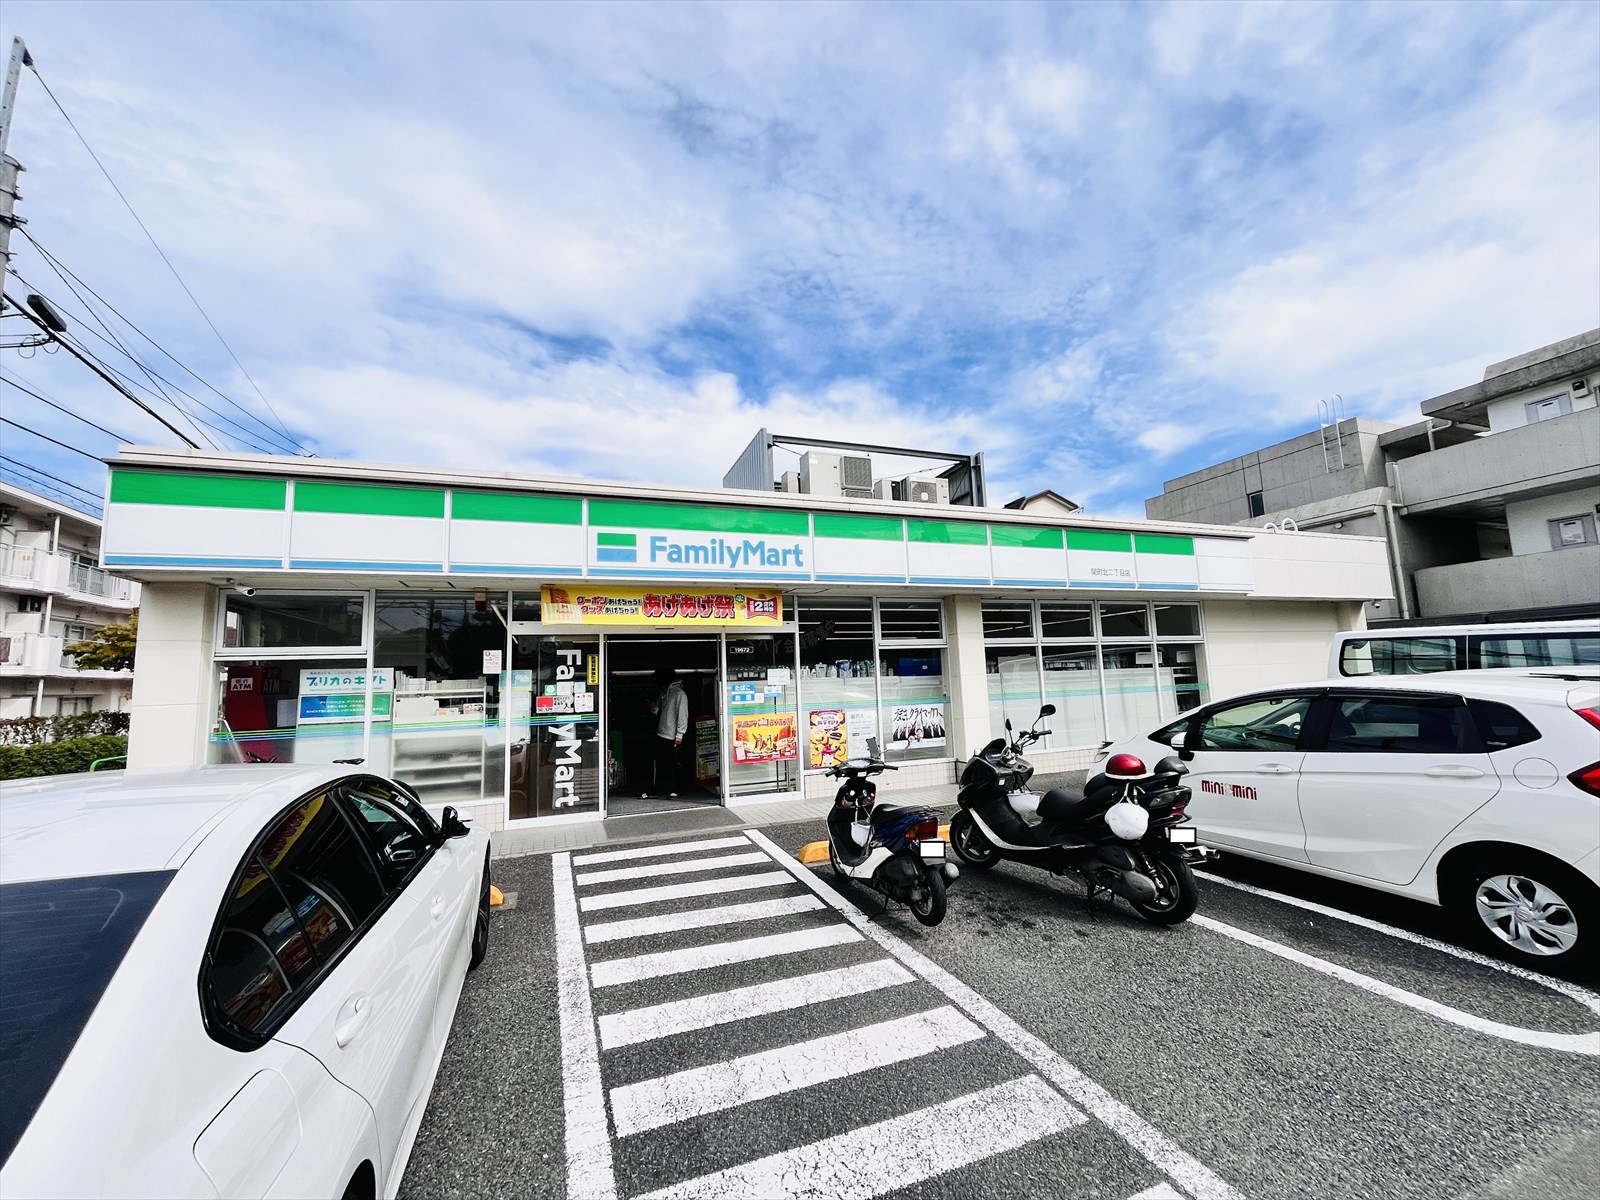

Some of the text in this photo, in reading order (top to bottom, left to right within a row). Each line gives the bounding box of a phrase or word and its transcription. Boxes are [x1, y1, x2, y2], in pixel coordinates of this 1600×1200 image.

[649, 535, 804, 569] FamilyMart
[641, 593, 735, 619] あげあげ祭
[1201, 779, 1258, 801] mini mini
